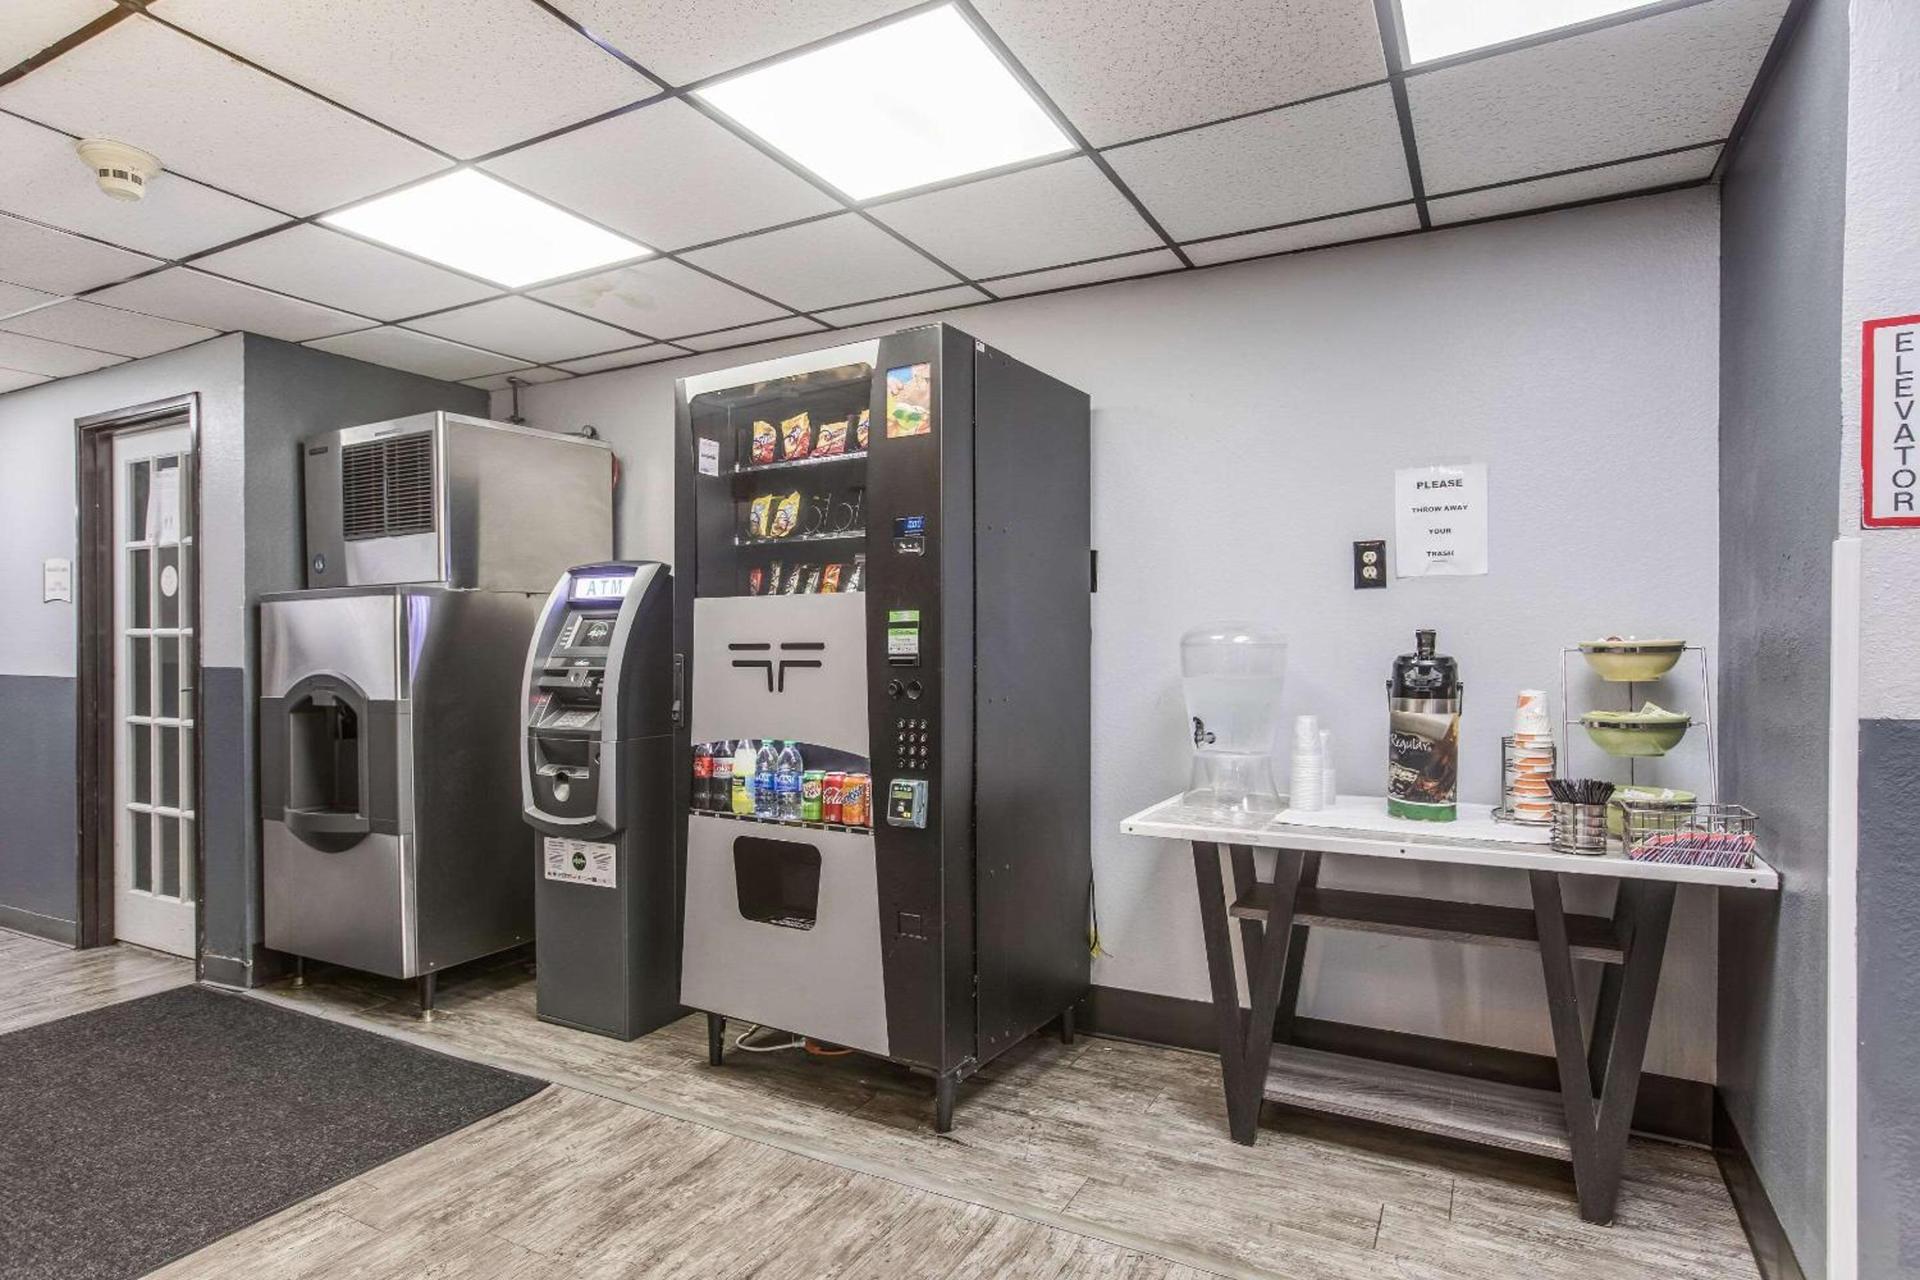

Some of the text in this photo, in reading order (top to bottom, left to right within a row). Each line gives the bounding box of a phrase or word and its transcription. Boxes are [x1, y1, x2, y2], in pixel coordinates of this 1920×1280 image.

[1892, 331, 1917, 512] ELEVATOR
[1416, 479, 1463, 489] PLEASE
[586, 579, 623, 596] ATM
